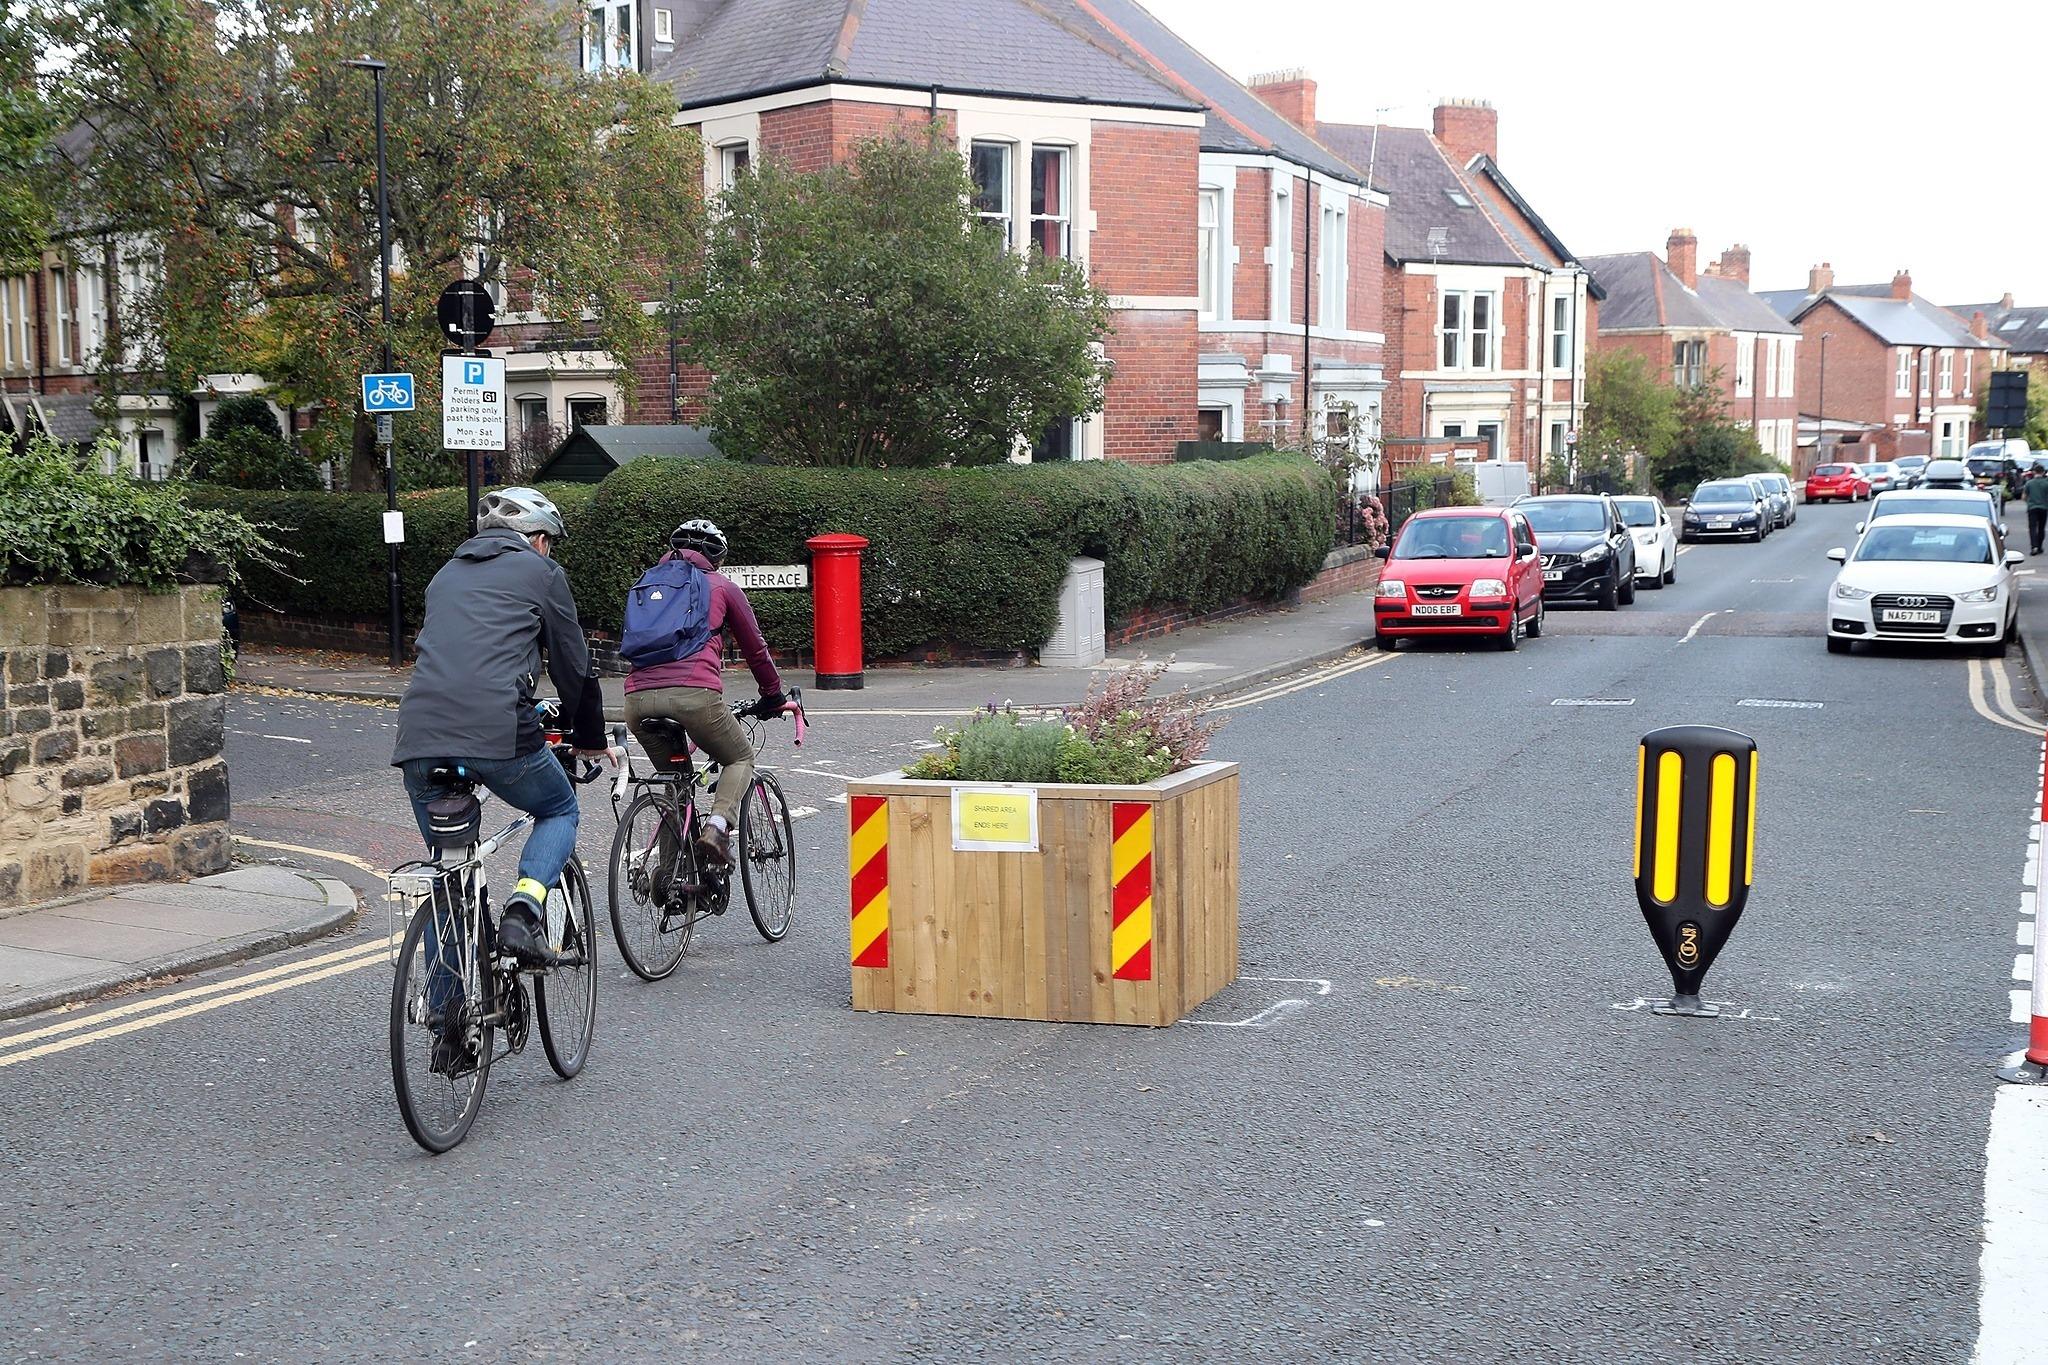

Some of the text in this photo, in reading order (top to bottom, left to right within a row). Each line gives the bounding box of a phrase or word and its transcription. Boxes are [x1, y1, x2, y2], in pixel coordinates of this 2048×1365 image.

[468, 364, 482, 382] P
[453, 387, 479, 395] Permit
[484, 392, 495, 402] G1
[450, 406, 498, 415] parking only
[479, 428, 493, 436] Sat
[471, 438, 489, 446] 6.30
[719, 566, 747, 574] SFORTH
[742, 573, 801, 586] TERRACE
[1415, 605, 1458, 614] ND06 EBF
[1888, 611, 1936, 621] NA67 TUH
[974, 805, 1017, 814] SHARED AREA
[974, 821, 1009, 830] ENDS HERE
